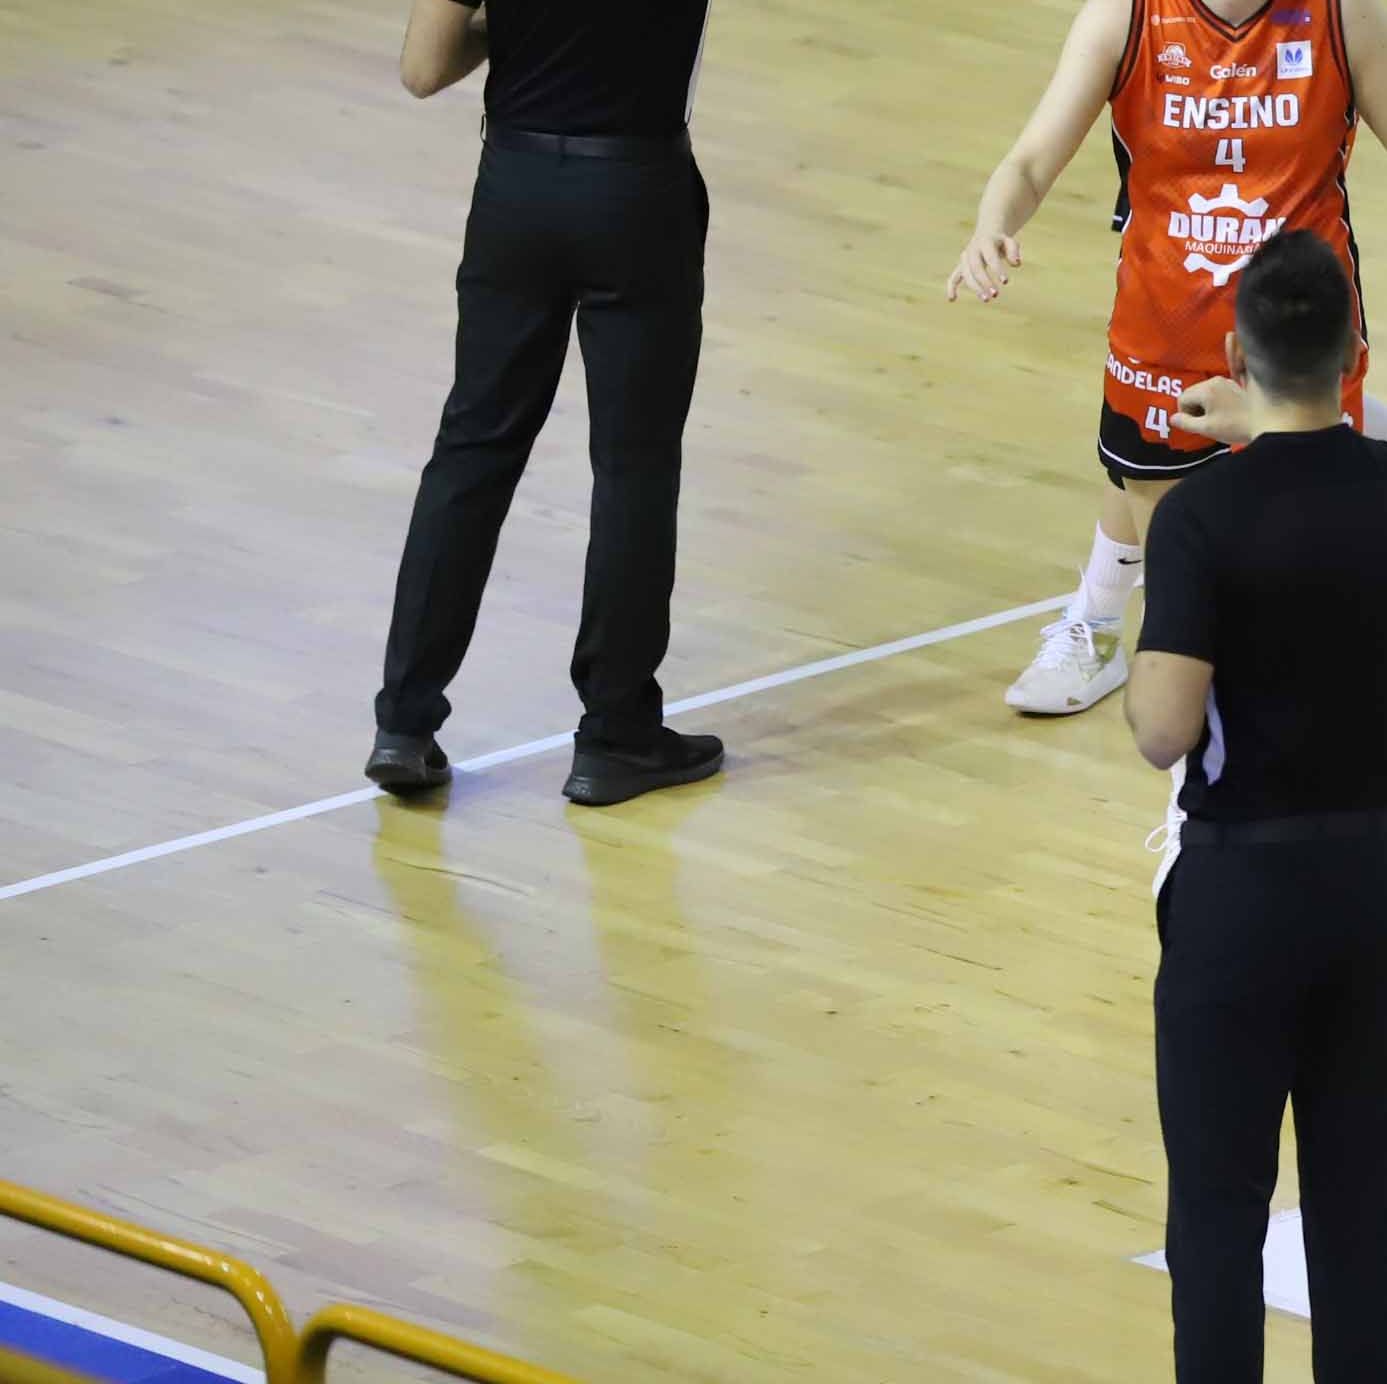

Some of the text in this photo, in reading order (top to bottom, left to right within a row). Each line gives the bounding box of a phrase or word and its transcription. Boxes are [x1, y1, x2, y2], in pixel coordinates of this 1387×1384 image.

[1163, 93, 1299, 129] ENSINO
[1215, 139, 1246, 172] 4
[1105, 353, 1182, 398] ANDELAS
[1145, 406, 1170, 439] 4
